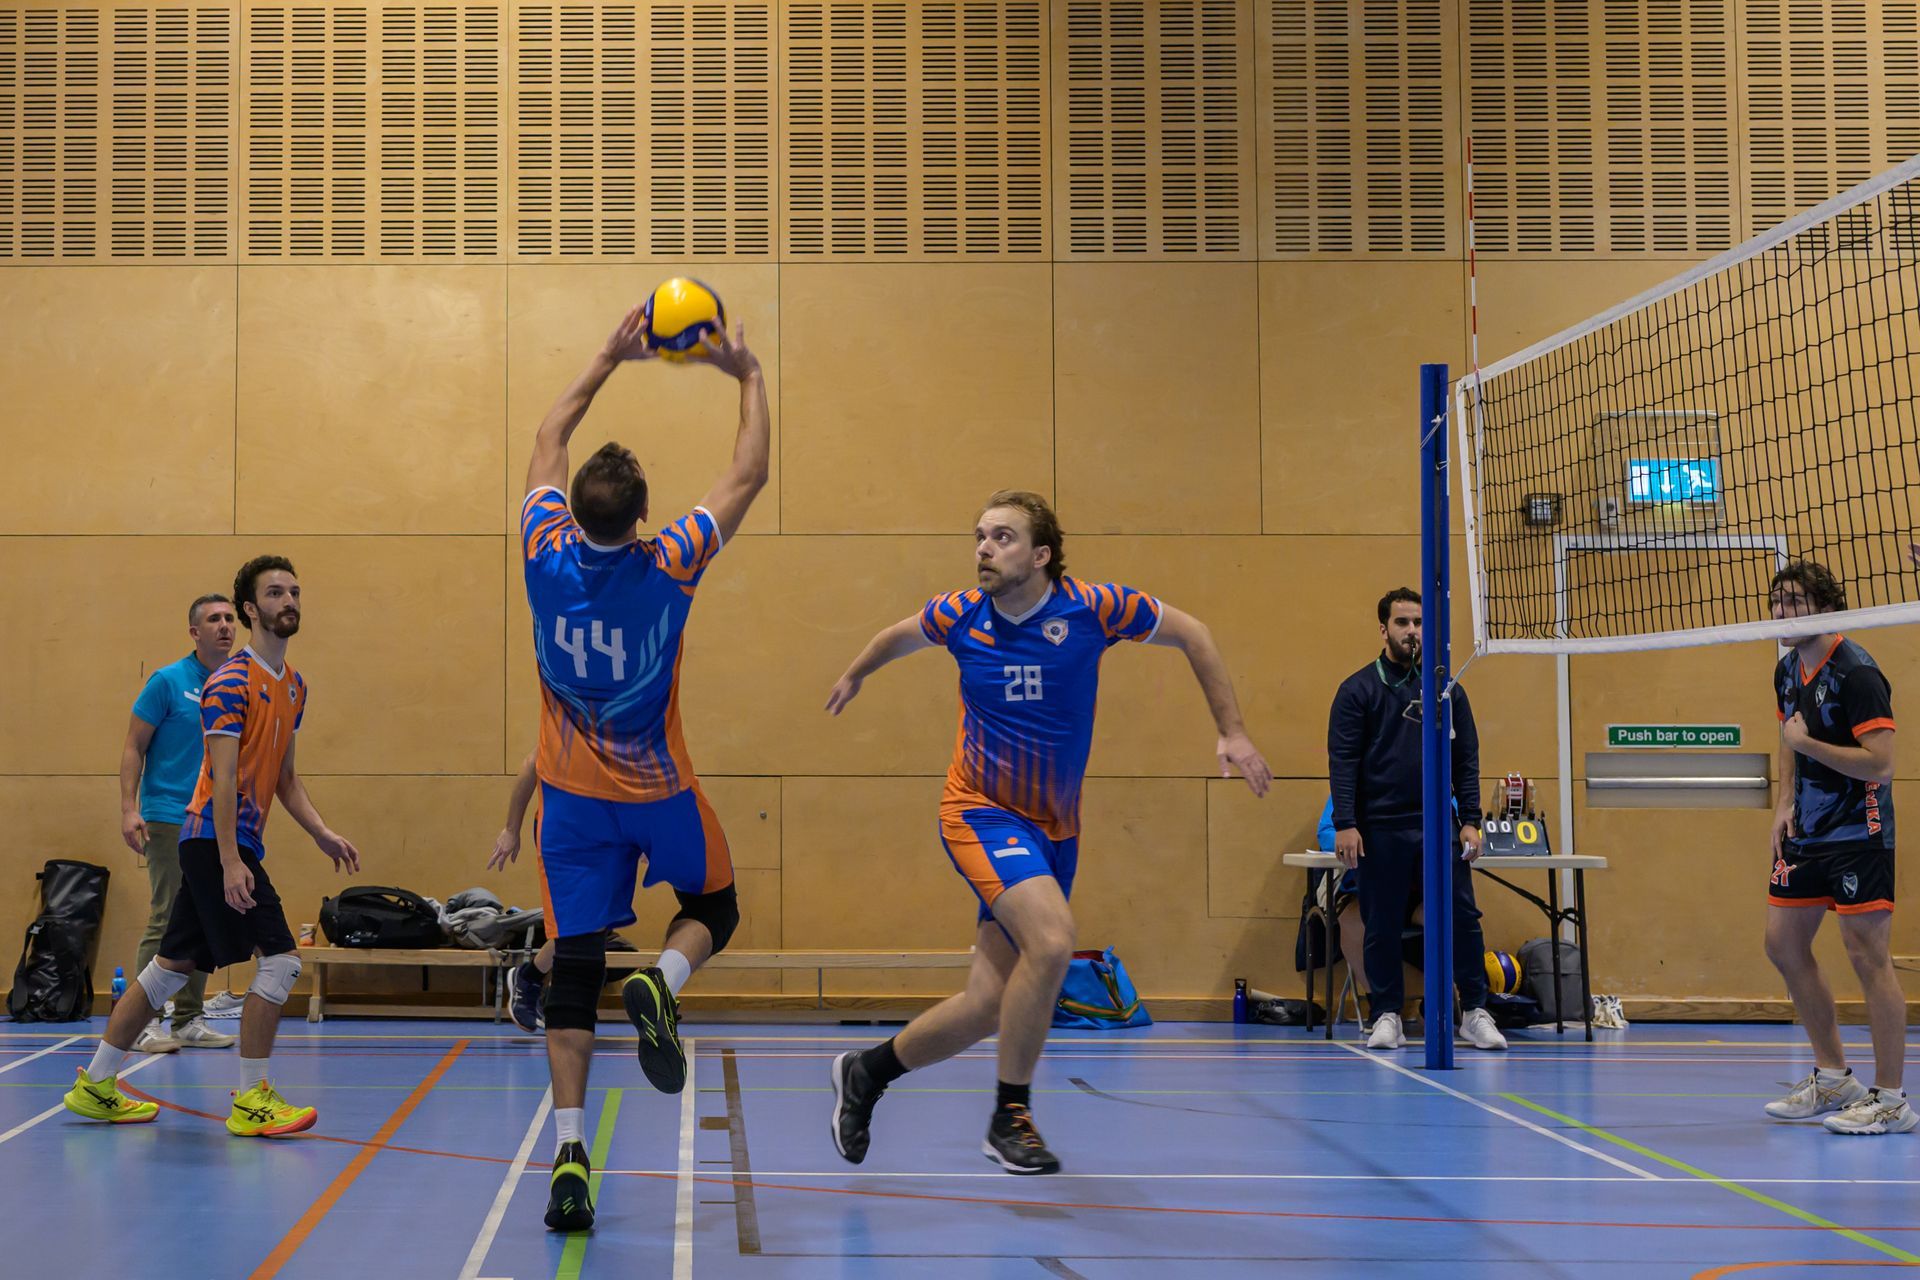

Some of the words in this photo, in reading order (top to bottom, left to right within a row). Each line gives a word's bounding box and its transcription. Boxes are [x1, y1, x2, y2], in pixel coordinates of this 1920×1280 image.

[555, 615, 627, 681] 44
[1003, 665, 1043, 701] 28
[1618, 729, 1652, 741] Push
[1656, 729, 1679, 741] bar
[1682, 730, 1696, 741] to
[1699, 732, 1734, 744] open
[1516, 821, 1538, 844] 0
